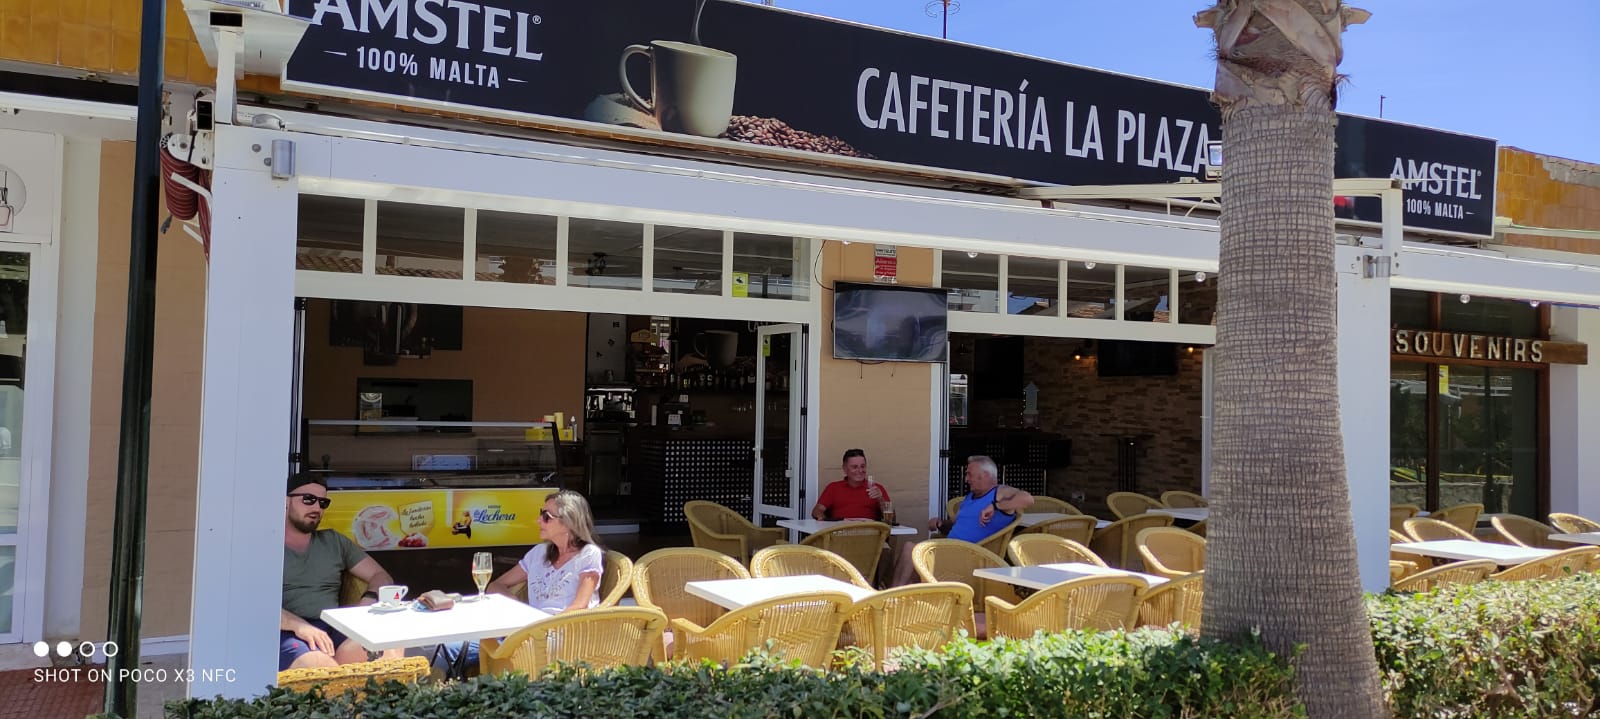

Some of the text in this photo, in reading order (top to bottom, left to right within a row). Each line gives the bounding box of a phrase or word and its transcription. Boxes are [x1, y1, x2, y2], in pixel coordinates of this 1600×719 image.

[356, 46, 500, 89] 100% MALTA
[856, 67, 1211, 174] CAFETERÍA LA PLAZA
[1390, 157, 1482, 200] AMSTEL
[1407, 198, 1464, 220] 100% MALTA
[1395, 329, 1543, 363] SOUVENIRS
